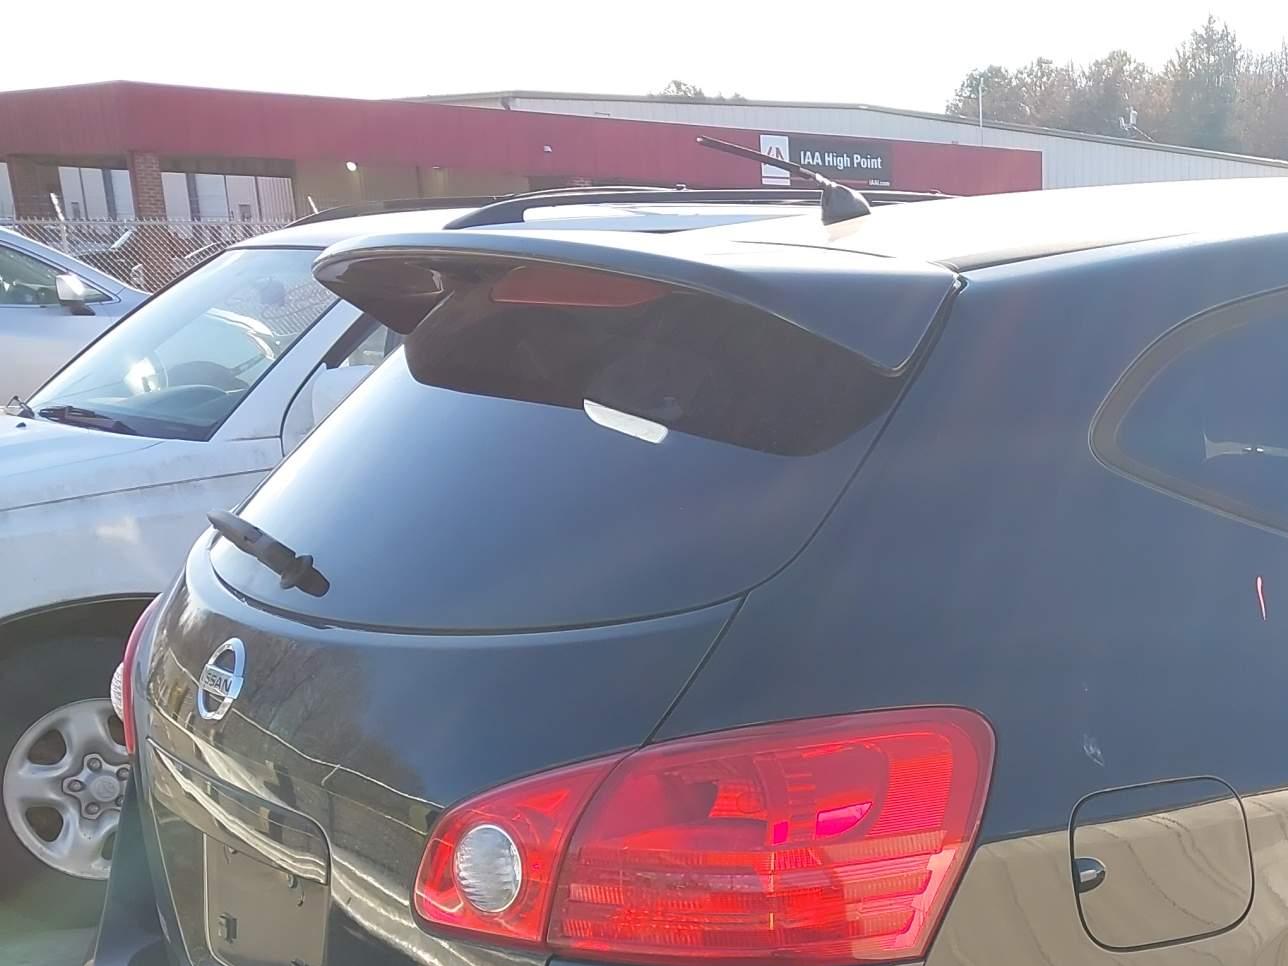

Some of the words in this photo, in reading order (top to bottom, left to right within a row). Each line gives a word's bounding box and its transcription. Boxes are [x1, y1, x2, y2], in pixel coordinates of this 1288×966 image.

[801, 151, 822, 166] IAA
[825, 152, 850, 169] High
[854, 154, 881, 168] Point
[203, 671, 232, 693] SSAN
